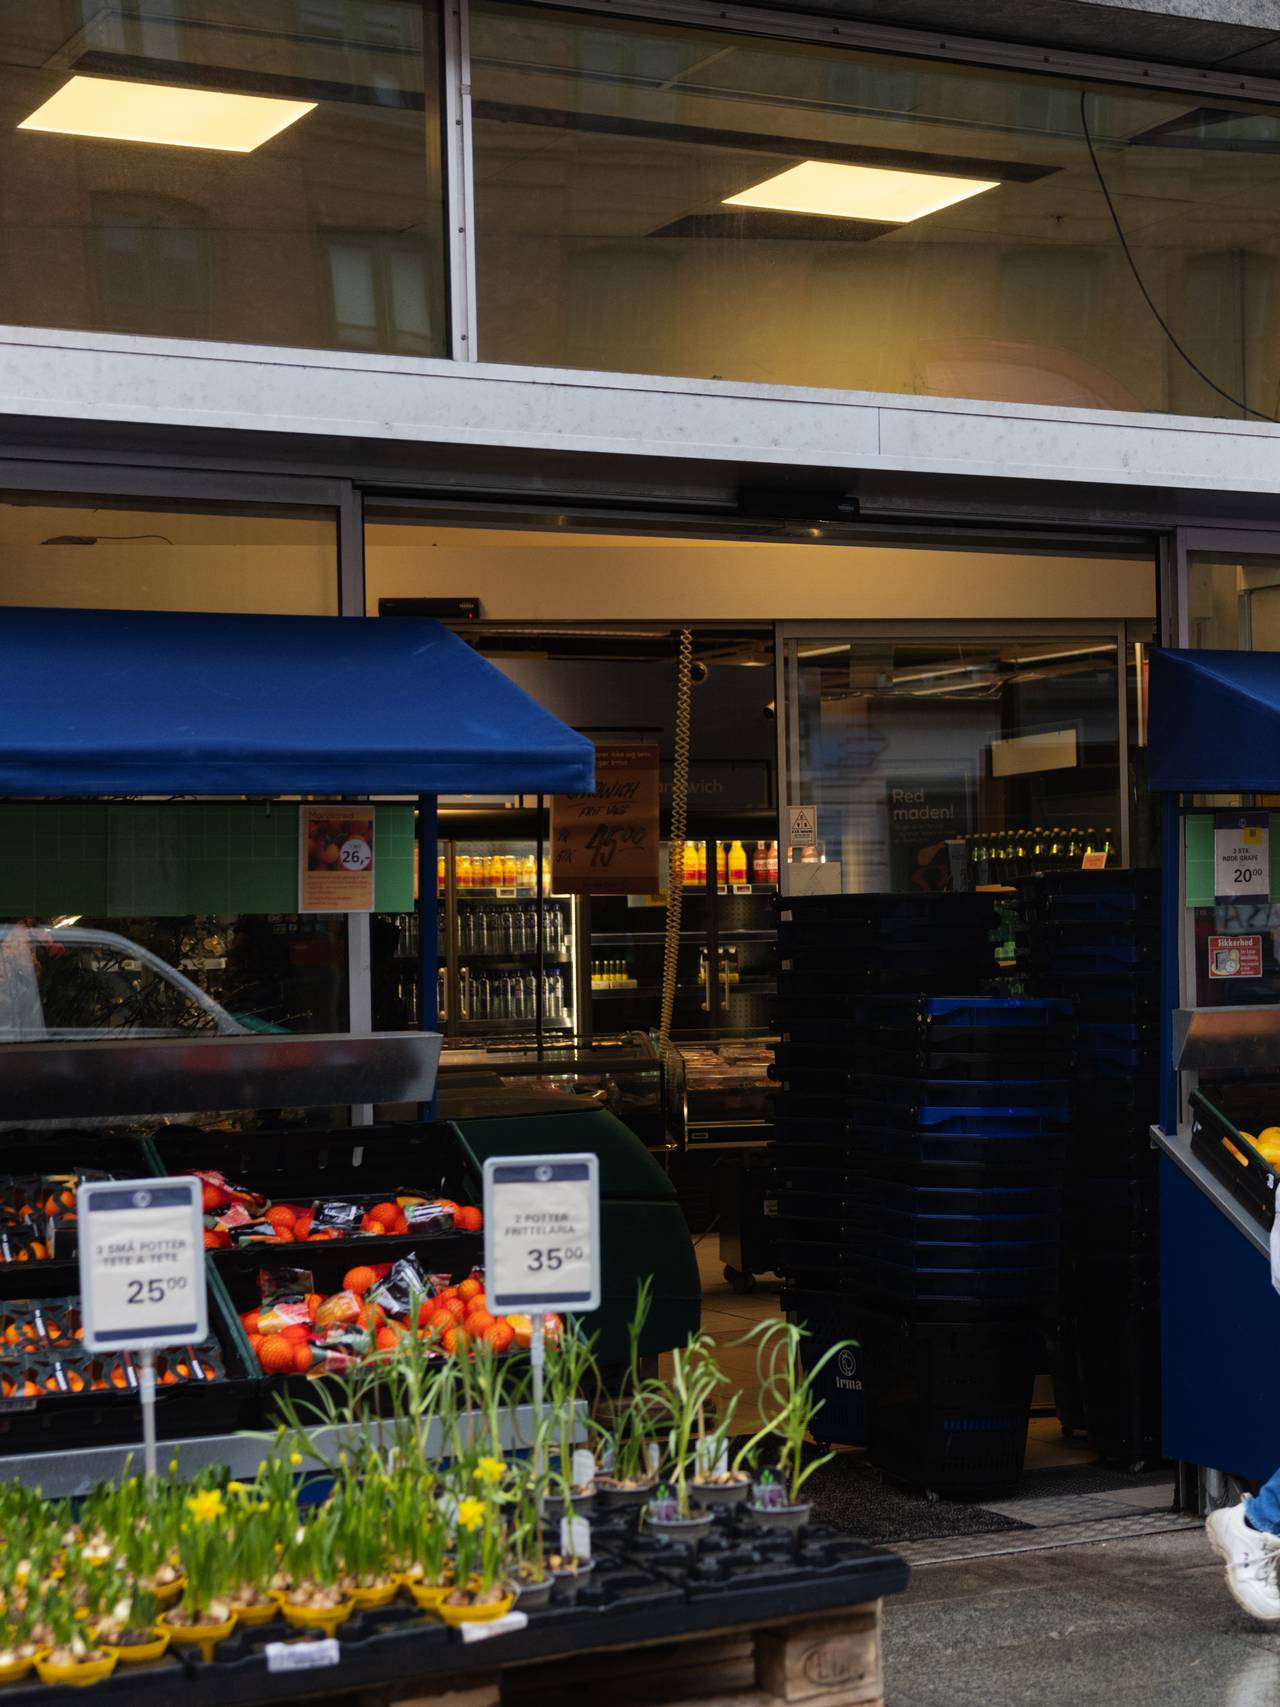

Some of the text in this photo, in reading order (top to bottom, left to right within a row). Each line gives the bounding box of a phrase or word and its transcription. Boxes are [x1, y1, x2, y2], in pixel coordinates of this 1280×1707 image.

[892, 787, 925, 803] Red
[1218, 938, 1253, 946] Sikkerhed
[525, 1213, 569, 1223] POTTER
[107, 1240, 136, 1254] SMÅ
[140, 1240, 186, 1252] POTTER
[102, 1256, 131, 1267] TETE
[150, 1253, 178, 1263] TETE
[836, 1376, 862, 1391] Irma
